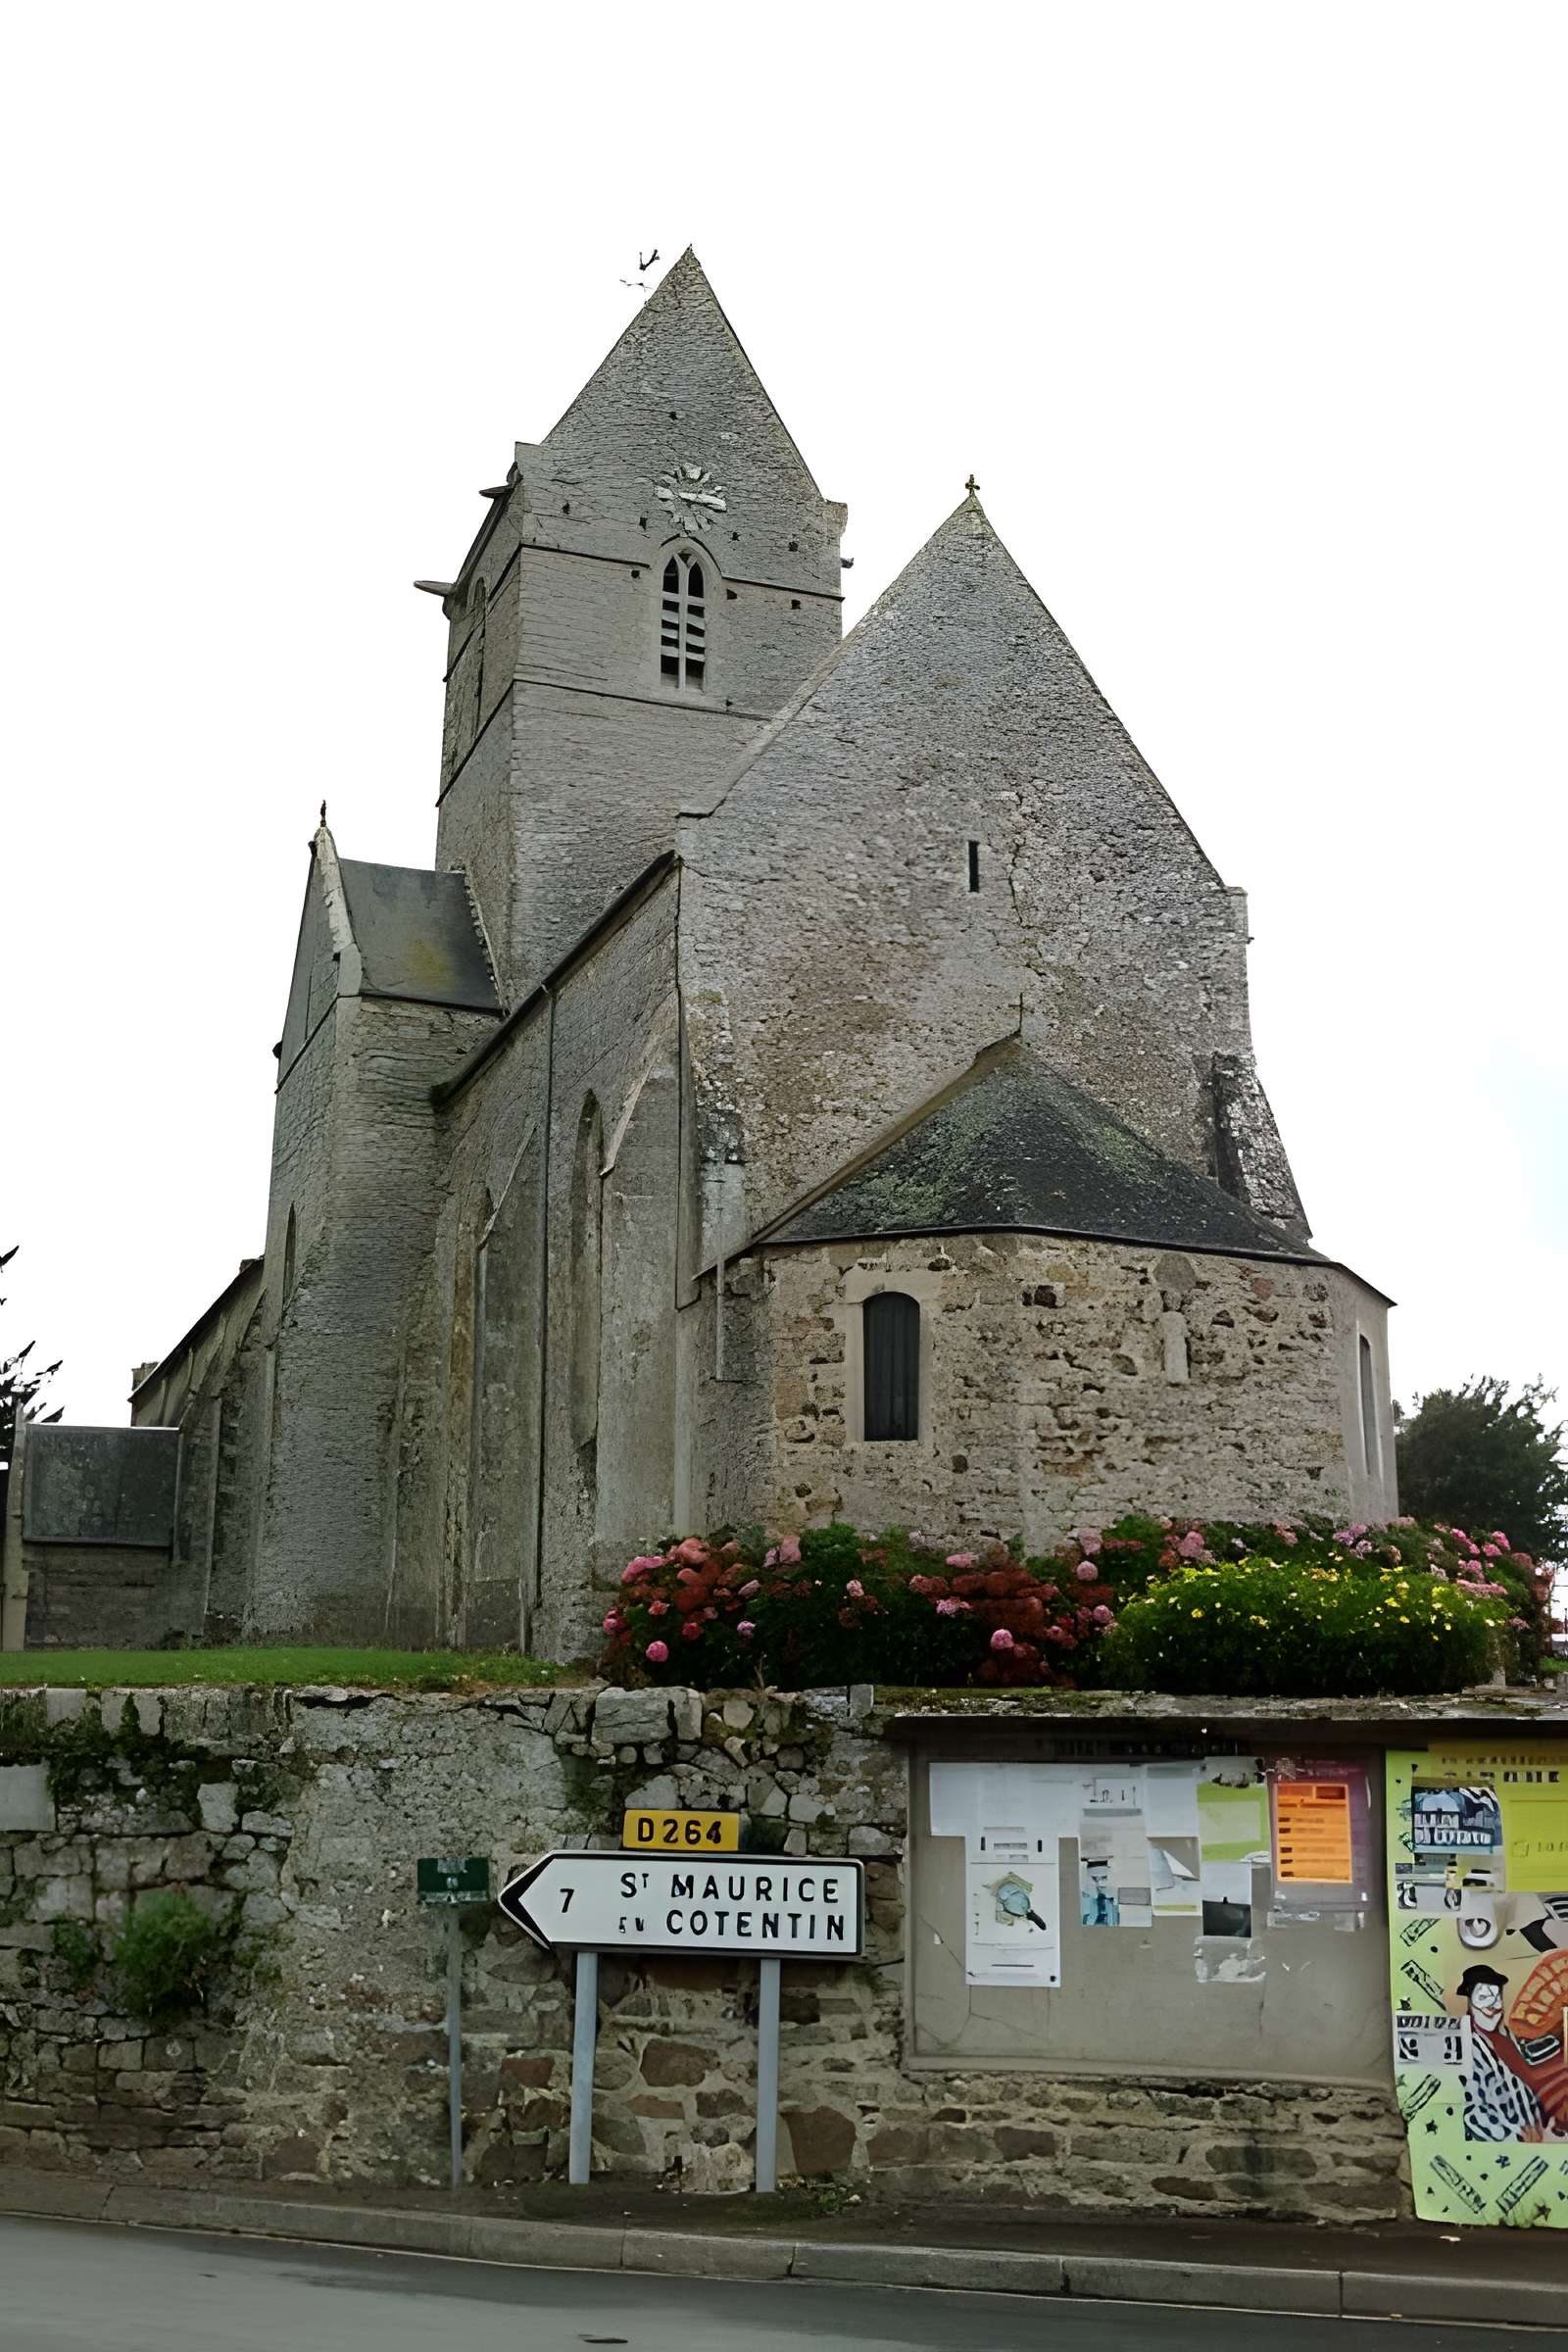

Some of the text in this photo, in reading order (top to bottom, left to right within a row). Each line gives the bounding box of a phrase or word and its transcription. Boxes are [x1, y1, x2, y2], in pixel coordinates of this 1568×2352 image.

[560, 1887, 575, 1914] 7
[670, 1874, 840, 1904] MAURICE
[665, 1909, 845, 1941] COTENTIN
